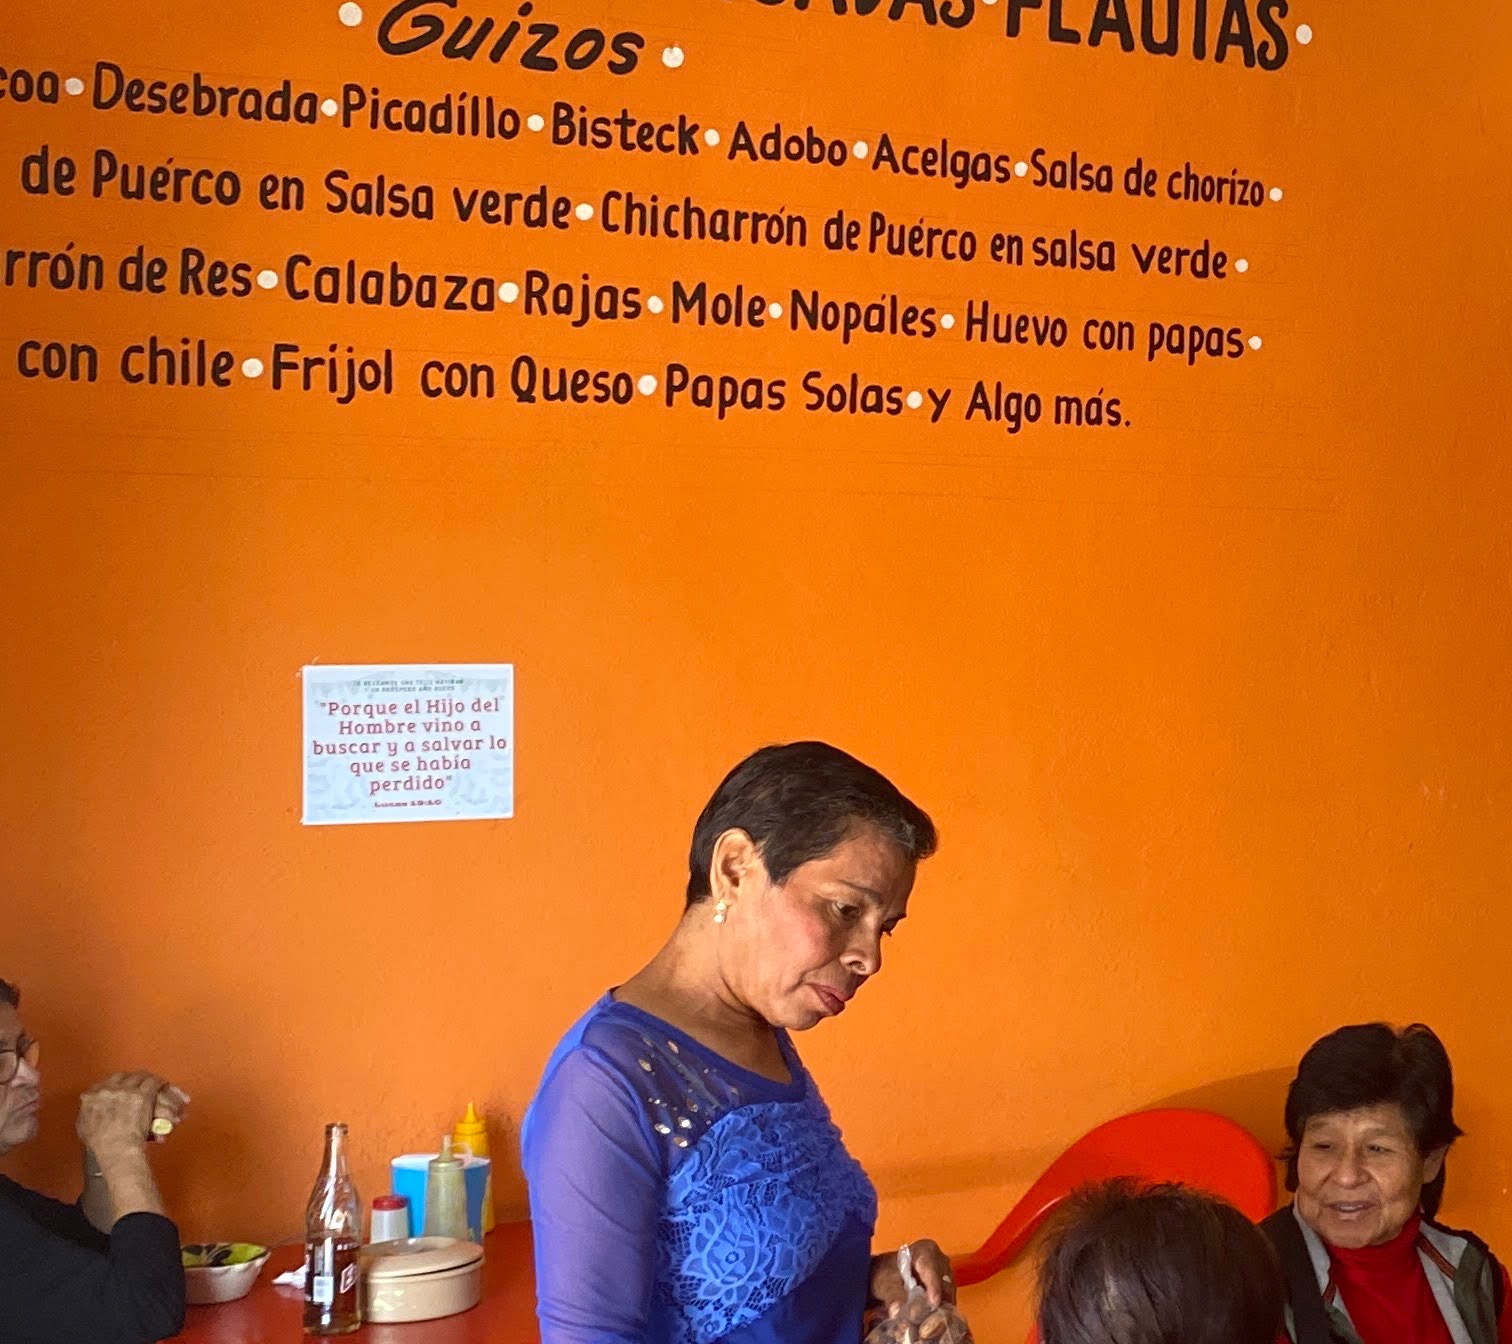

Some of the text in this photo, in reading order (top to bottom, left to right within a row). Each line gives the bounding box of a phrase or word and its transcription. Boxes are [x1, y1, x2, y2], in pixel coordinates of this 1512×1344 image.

[92, 61, 318, 125] Desebrada
[552, 101, 700, 156] Bisteck
[728, 121, 848, 167] Adobo
[872, 133, 1011, 189] Acelgas
[1030, 147, 1113, 193] Salsa
[1123, 157, 1158, 198] de
[20, 144, 1228, 279] de Puérco en Salsa verde Chicharrón de Puérco en salsa verde
[4, 241, 1245, 366] rrón de Res Calabaza Rajas Mole Nopáles Huevo con papas
[17, 339, 98, 383] con
[120, 335, 235, 388] chile
[421, 360, 495, 398] con
[511, 355, 633, 405] Queso
[665, 363, 786, 420] Papas
[802, 371, 903, 416] Solas
[927, 388, 951, 423] y
[965, 380, 1042, 434] Algo
[1054, 387, 1131, 427] más.
[320, 702, 397, 719] "Porque
[404, 700, 420, 715] el
[427, 699, 465, 717] Hijo
[338, 718, 481, 735] Hombre vino a
[312, 735, 507, 756] buscar y a salvar lo
[350, 754, 471, 777] que se había
[369, 775, 453, 796] perdido"
